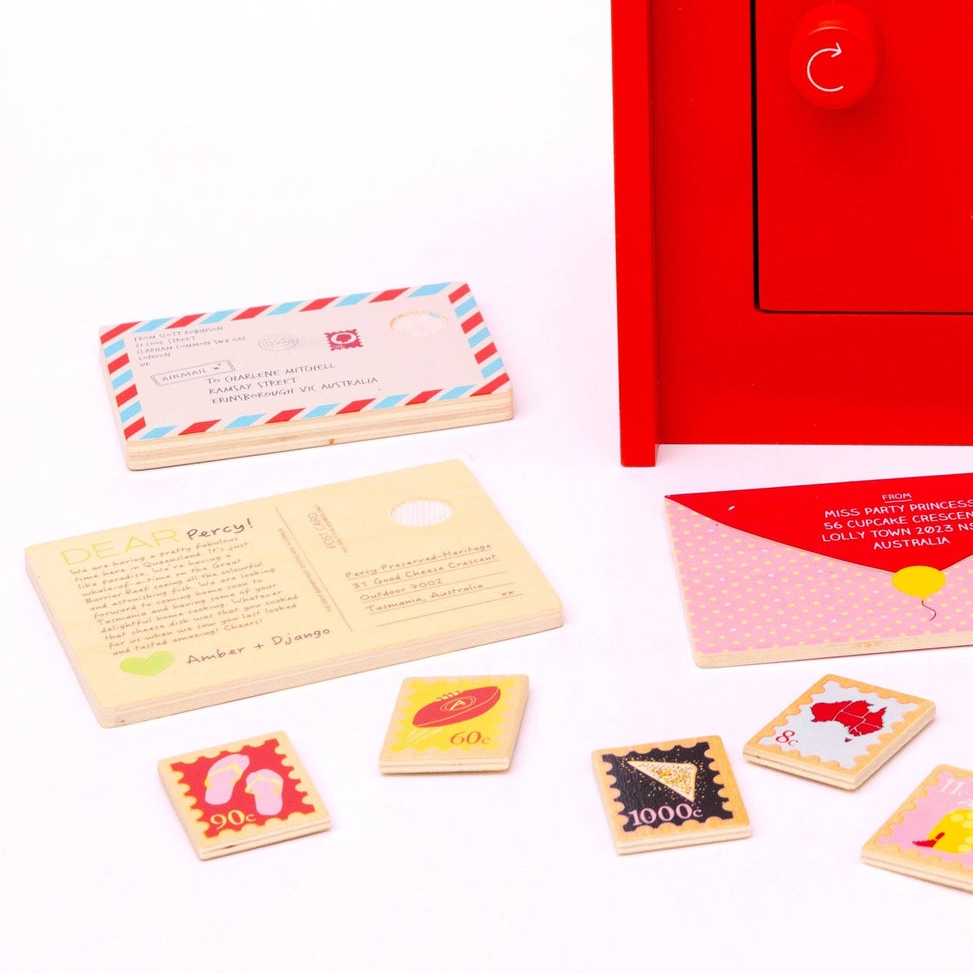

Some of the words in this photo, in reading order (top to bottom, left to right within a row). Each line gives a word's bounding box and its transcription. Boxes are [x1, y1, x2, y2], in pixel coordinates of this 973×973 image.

[162, 369, 206, 382] AIRMAIL
[224, 369, 278, 382] CHARLENE
[284, 362, 335, 375] MITCHELL
[208, 382, 252, 394] RAMSAY
[256, 376, 297, 388] STREET
[211, 387, 294, 404] ERINSBOROUGH
[298, 384, 316, 392] VIC
[320, 376, 379, 390] AUSTRALIA
[882, 493, 912, 501] FROM
[824, 508, 860, 518] MISS
[865, 504, 905, 515] PARTY
[823, 521, 843, 530] 56
[846, 516, 908, 528] CUPCAKE
[60, 528, 180, 565] DEAR
[186, 517, 254, 540] Percy!
[821, 531, 865, 542] LOLLY
[869, 527, 911, 538] TOWN
[873, 536, 950, 550] AUSTRALIA
[372, 573, 402, 585] Good
[186, 646, 246, 664] Amber
[253, 642, 265, 650] +
[270, 627, 331, 646] Django
[450, 730, 491, 746] 60c
[775, 729, 799, 747] 8c
[210, 809, 257, 831] 90c
[628, 803, 704, 826] 1000c
